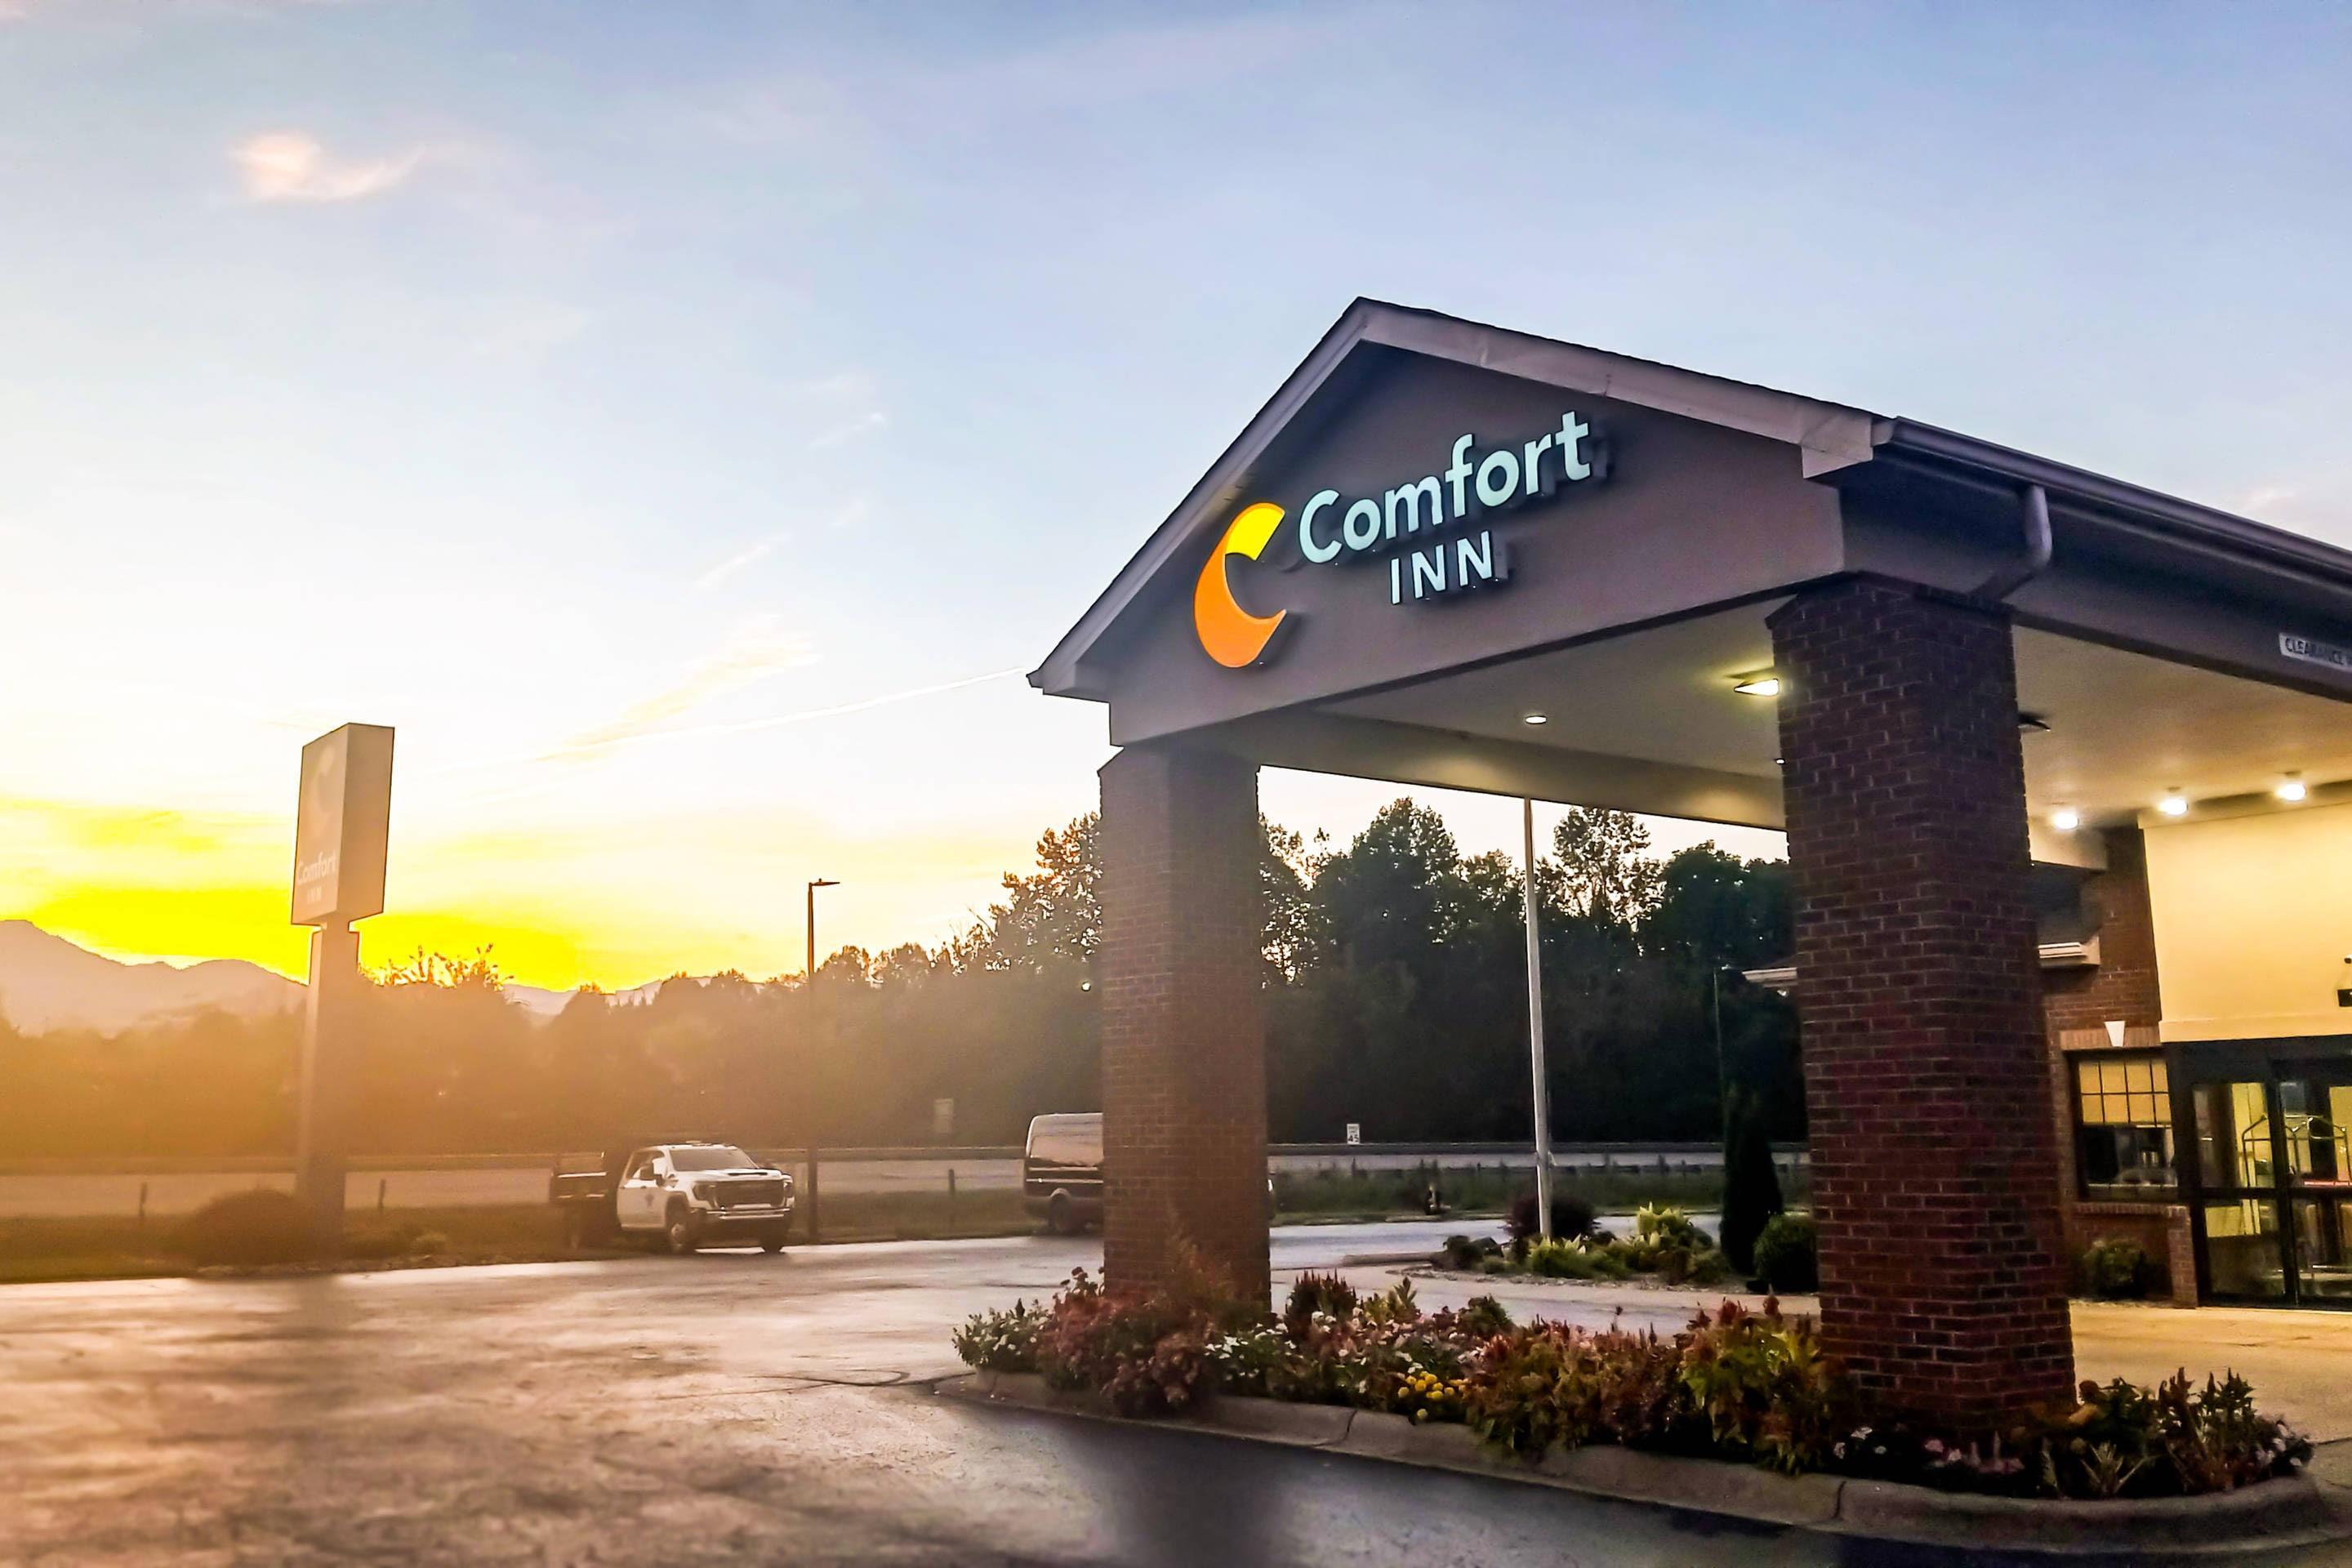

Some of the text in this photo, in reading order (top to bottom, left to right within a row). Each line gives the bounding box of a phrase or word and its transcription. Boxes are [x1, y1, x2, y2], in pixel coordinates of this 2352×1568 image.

[1298, 410, 1591, 564] Comfort
[1390, 530, 1493, 605] INN
[296, 851, 336, 885] Comfort
